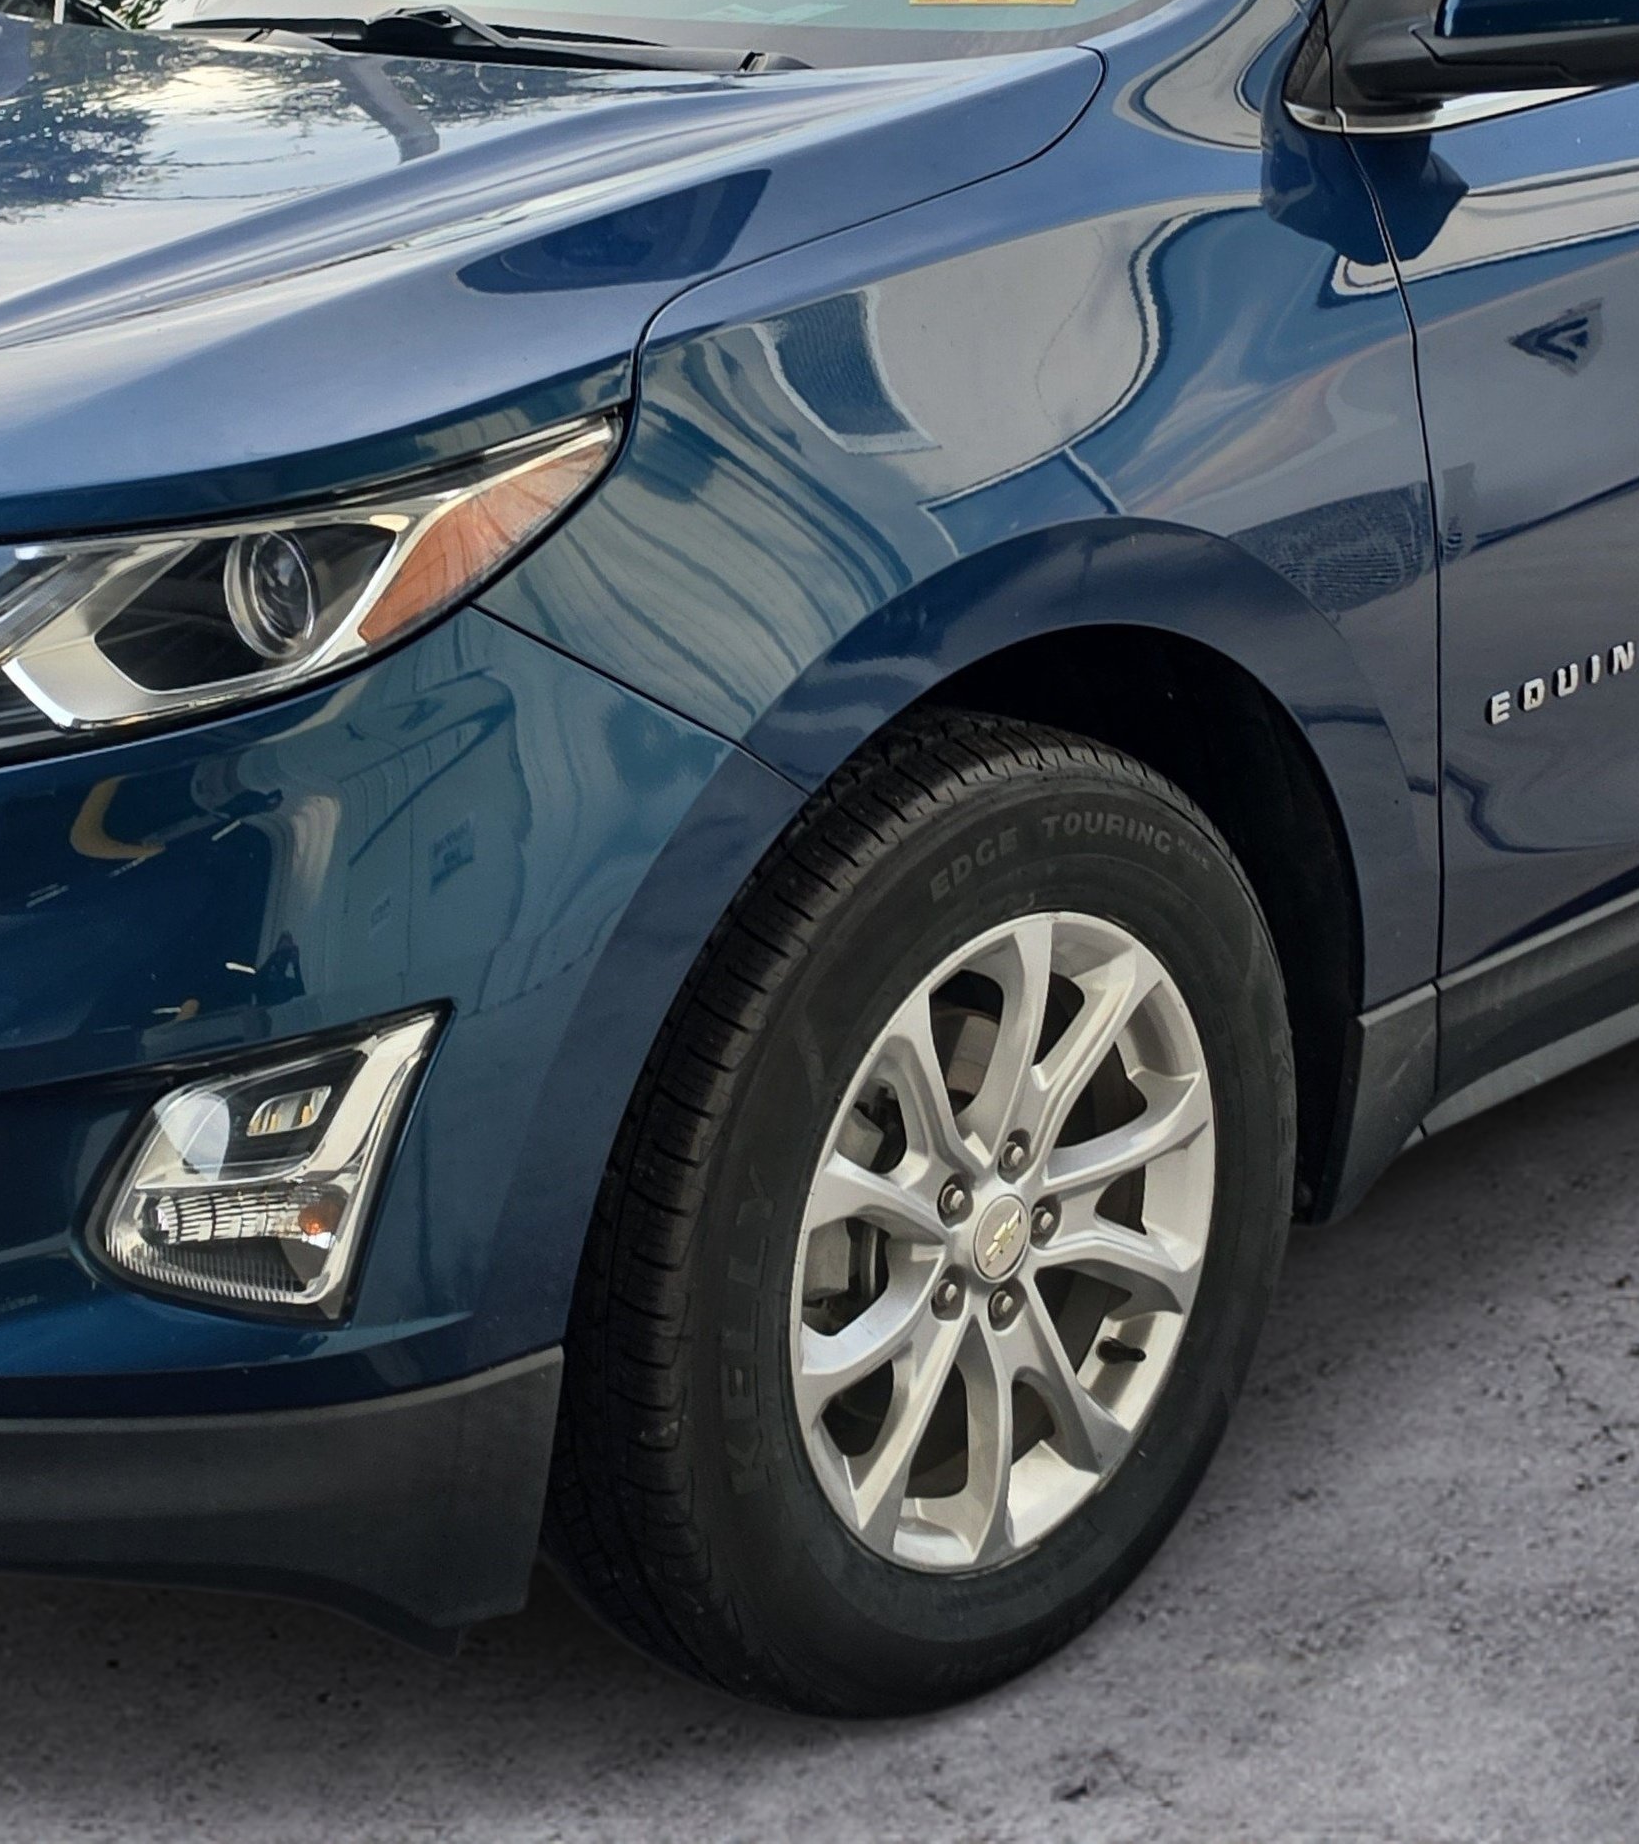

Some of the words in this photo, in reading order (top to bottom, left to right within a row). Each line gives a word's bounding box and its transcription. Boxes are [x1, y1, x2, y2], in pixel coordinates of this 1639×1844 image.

[929, 827, 1019, 904] EDGE
[1041, 811, 1172, 855] TOURING
[721, 1162, 777, 1496] KELLY
